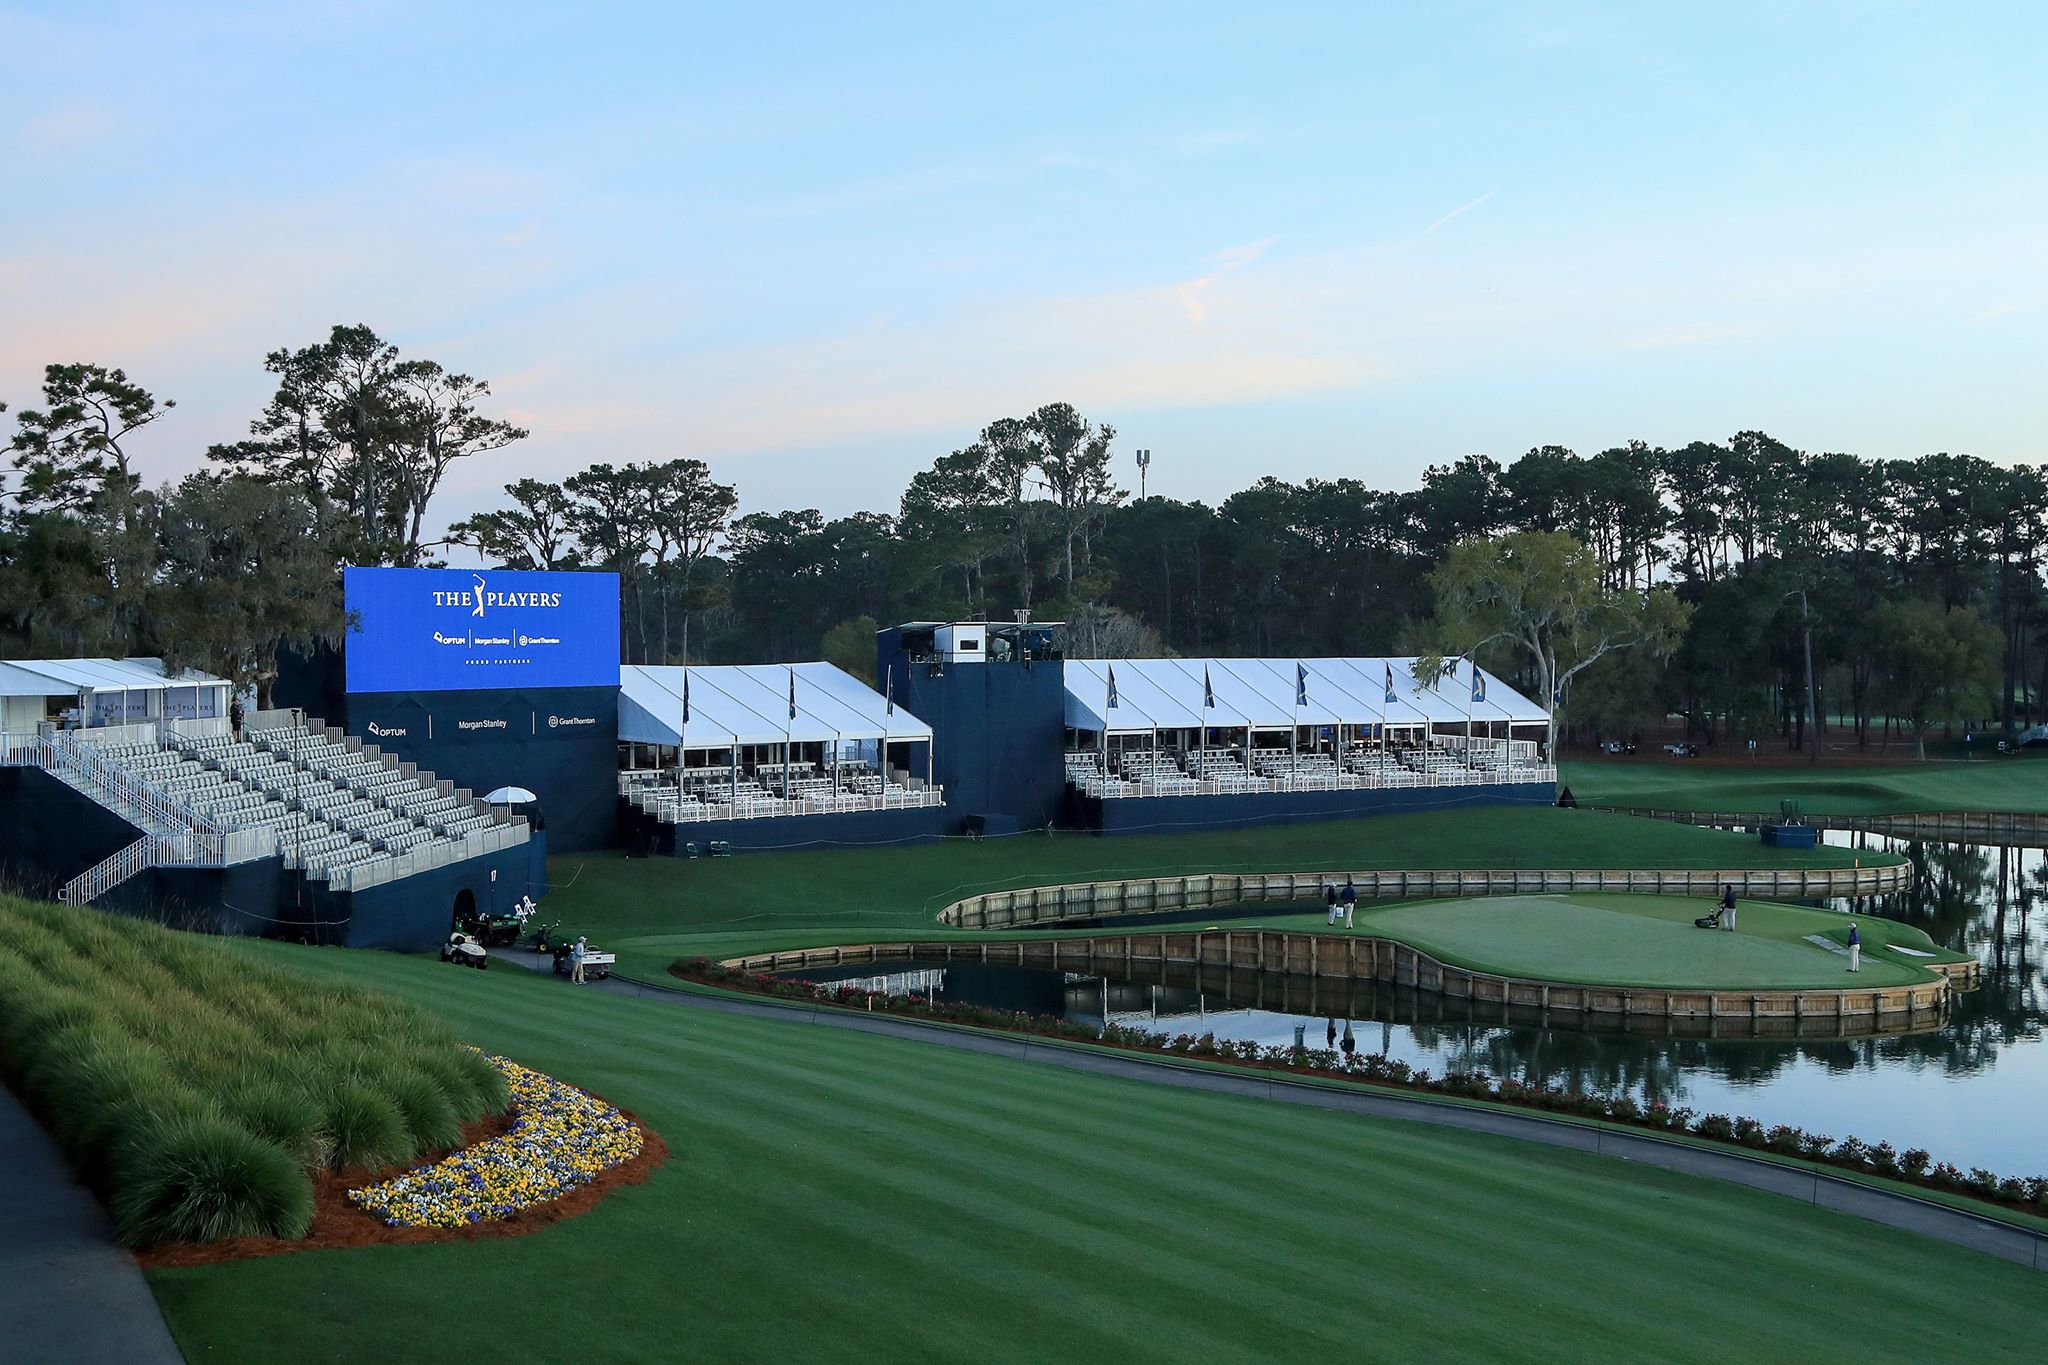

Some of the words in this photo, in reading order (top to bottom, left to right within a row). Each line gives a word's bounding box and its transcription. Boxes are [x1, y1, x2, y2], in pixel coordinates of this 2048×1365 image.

[433, 592, 471, 606] THE
[486, 593, 560, 607] PLAYERS
[444, 637, 466, 645] OPTUM
[459, 721, 483, 730] Morgan
[483, 720, 507, 728] Stanley
[380, 728, 406, 737] OPTUM
[491, 870, 497, 882] 17
